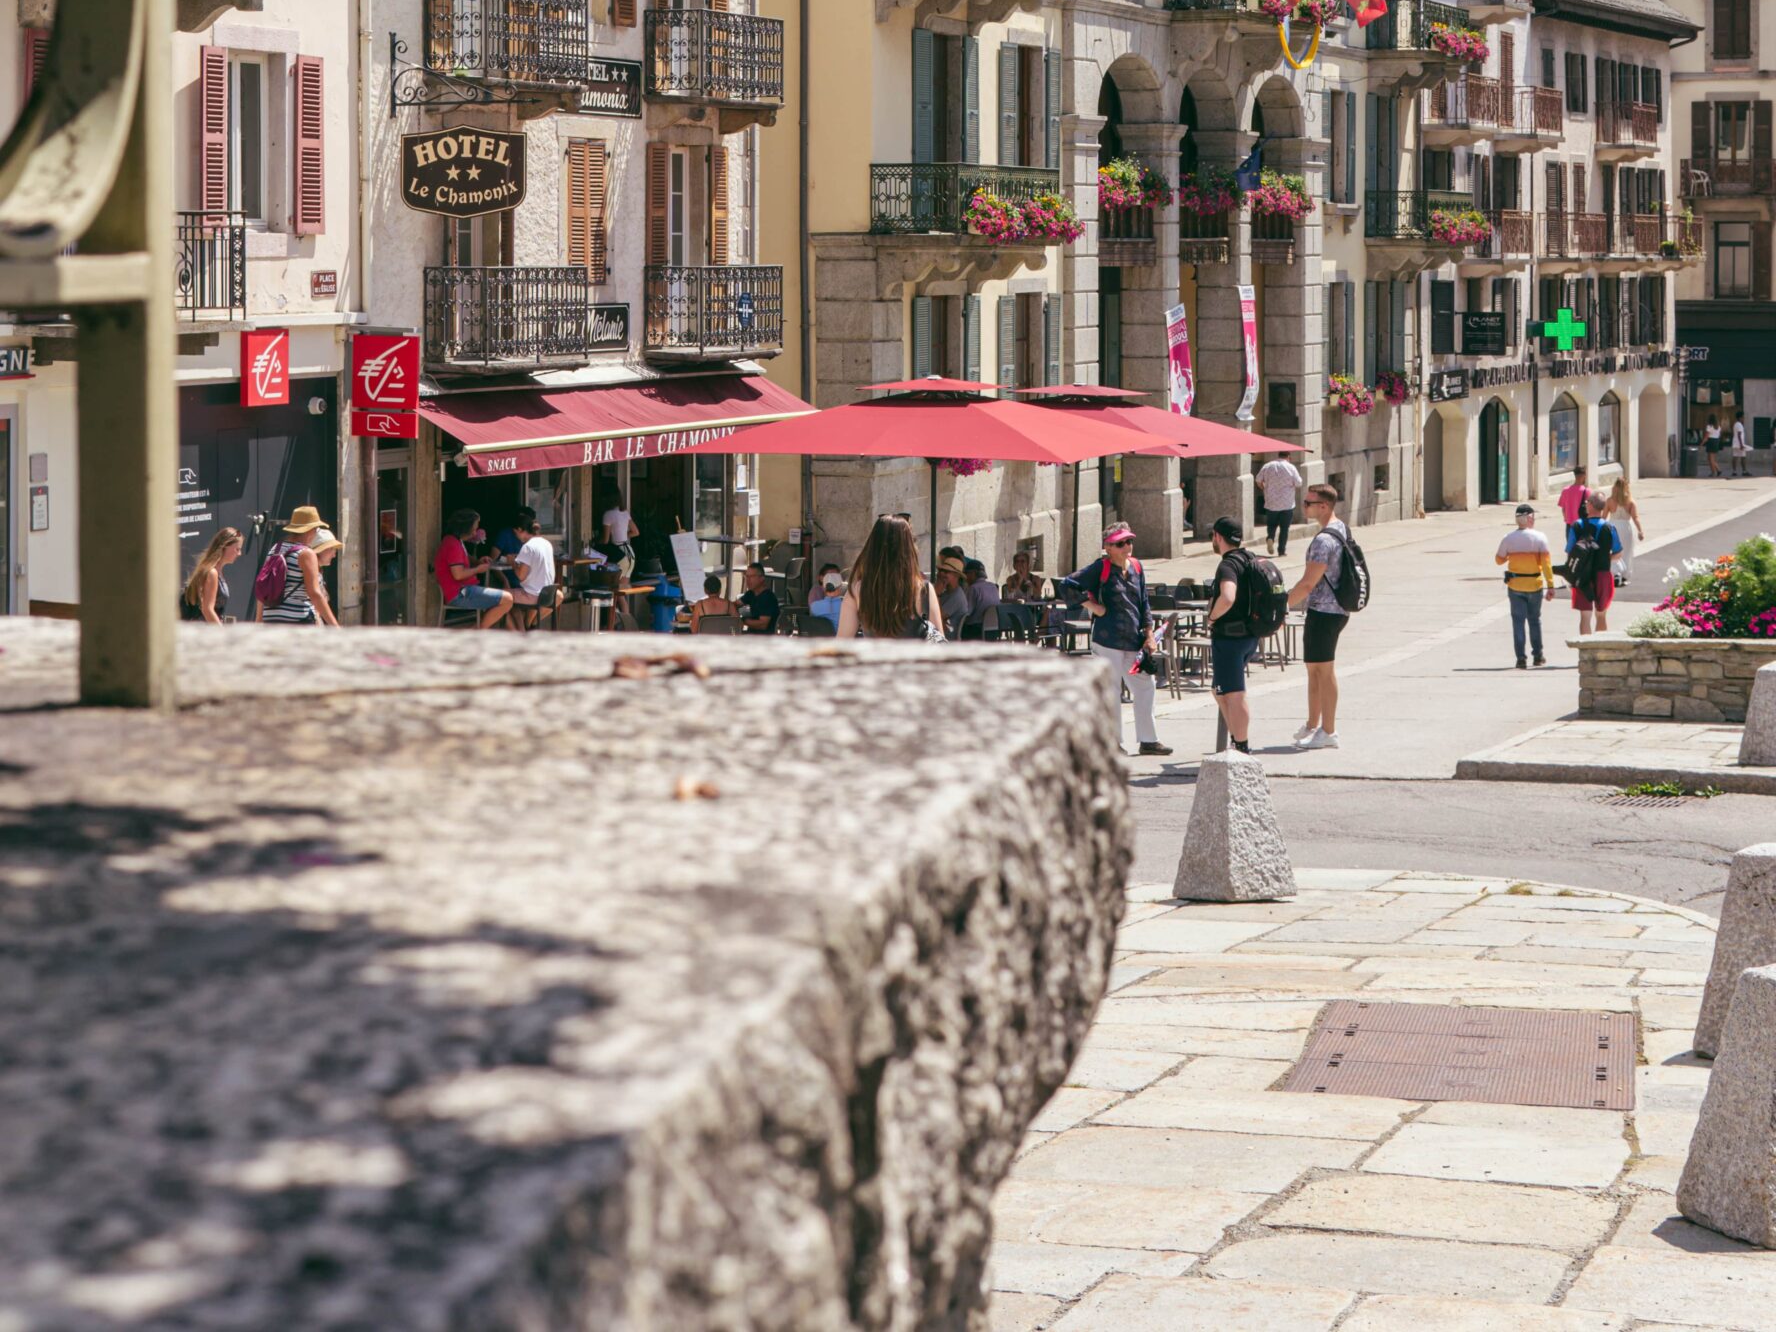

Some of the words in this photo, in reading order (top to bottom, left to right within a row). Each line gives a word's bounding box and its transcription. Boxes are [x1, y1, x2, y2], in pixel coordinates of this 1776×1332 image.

[413, 135, 512, 167] HOTEL
[409, 177, 429, 198] Le
[435, 179, 518, 206] Chamonix
[582, 439, 614, 464] BAR
[625, 436, 645, 459] LE
[487, 457, 518, 472] SNACK
